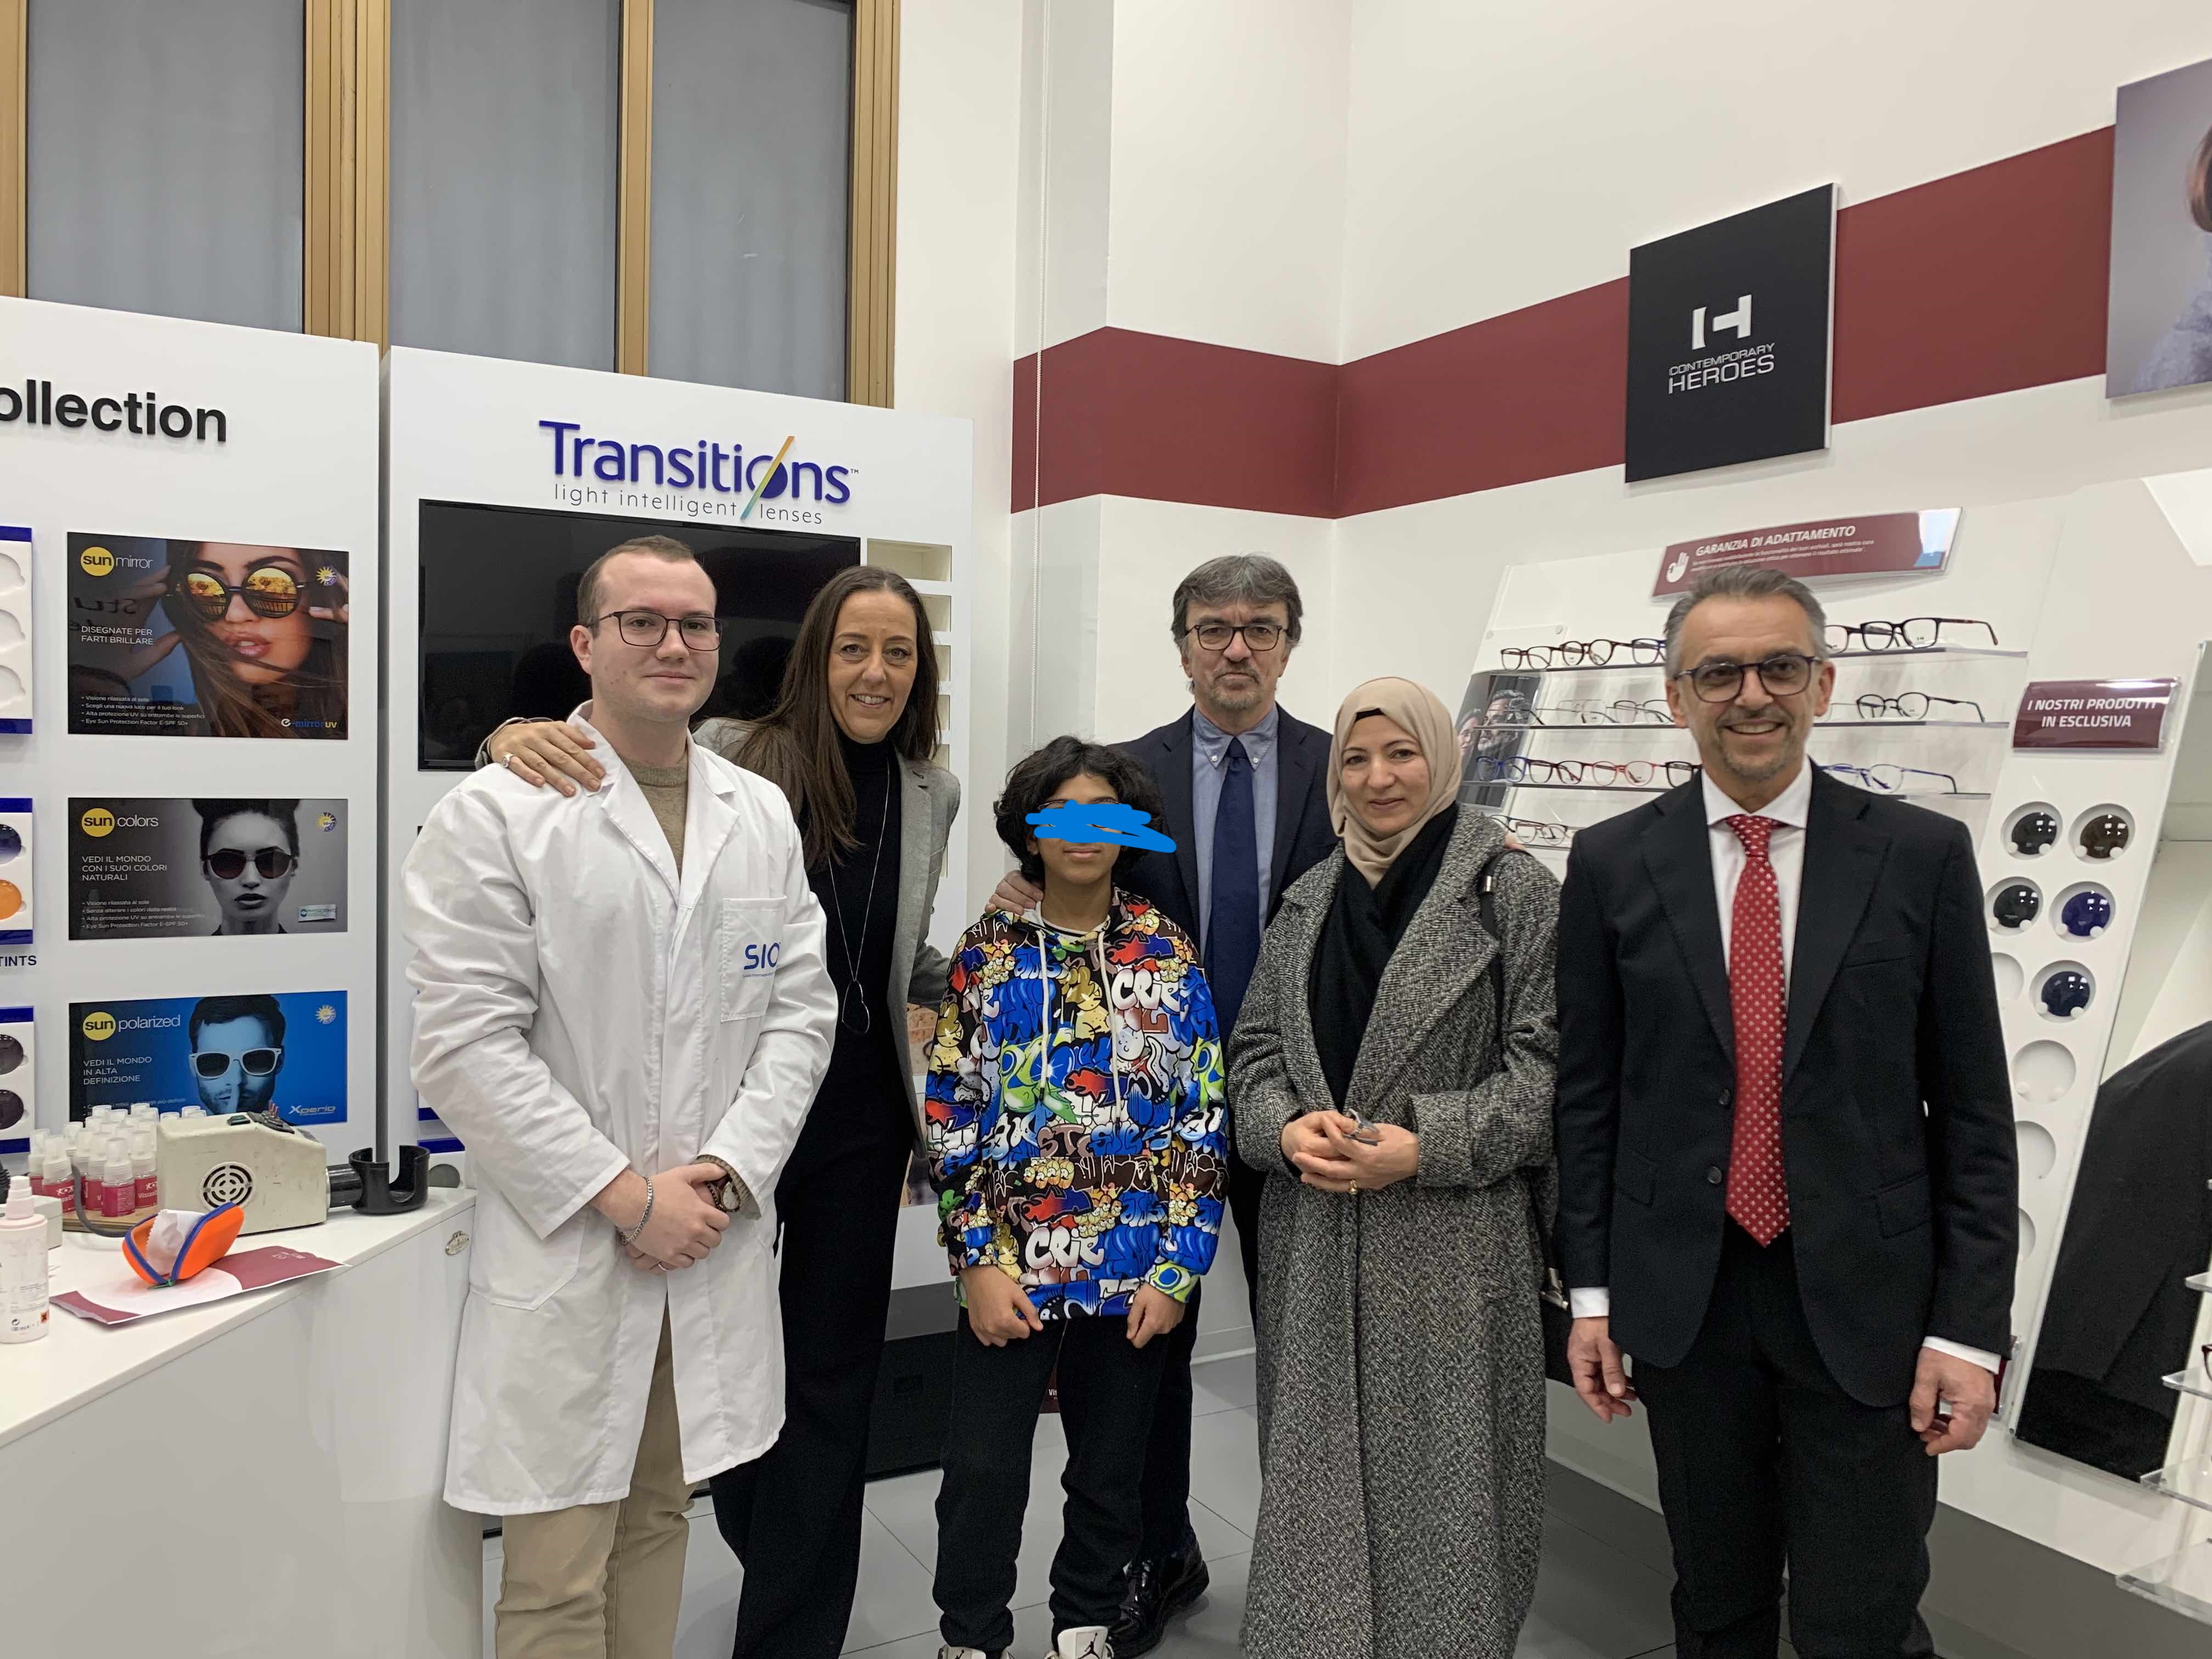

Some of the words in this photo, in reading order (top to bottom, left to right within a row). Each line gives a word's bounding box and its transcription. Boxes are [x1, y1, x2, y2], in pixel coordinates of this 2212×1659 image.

[1668, 342, 1775, 376] CONTEMPORARY
[1668, 354, 1775, 395] HEROES
[539, 420, 851, 504] Transitions
[554, 483, 609, 506] light
[619, 489, 737, 517] intelligent
[760, 503, 823, 524] lenses
[1695, 539, 1748, 556] GARANZIA
[1750, 536, 1764, 548] DI
[1764, 525, 1856, 546] ADATTAMENTO
[83, 555, 112, 566] sun
[116, 555, 154, 569] mirror
[82, 625, 132, 635] DISEGNATE
[135, 628, 153, 636] PER
[82, 635, 108, 643] FARTI
[110, 635, 154, 645] BRILLARE
[2027, 699, 2033, 710] I
[2035, 698, 2084, 710] NOSTRI
[2086, 698, 2156, 710] PRODOTTI
[2041, 715, 2056, 728] IN
[2058, 715, 2132, 727] ESCLUSIVA
[84, 816, 113, 827] sun
[117, 815, 159, 827] colors
[82, 873, 128, 882] NATURALI
[84, 1019, 114, 1031] sun
[118, 1014, 180, 1032] polarized
[117, 1057, 152, 1065] MONDO
[83, 1075, 141, 1085] DEFINIZIONE
[288, 1105, 336, 1116] Xperio
